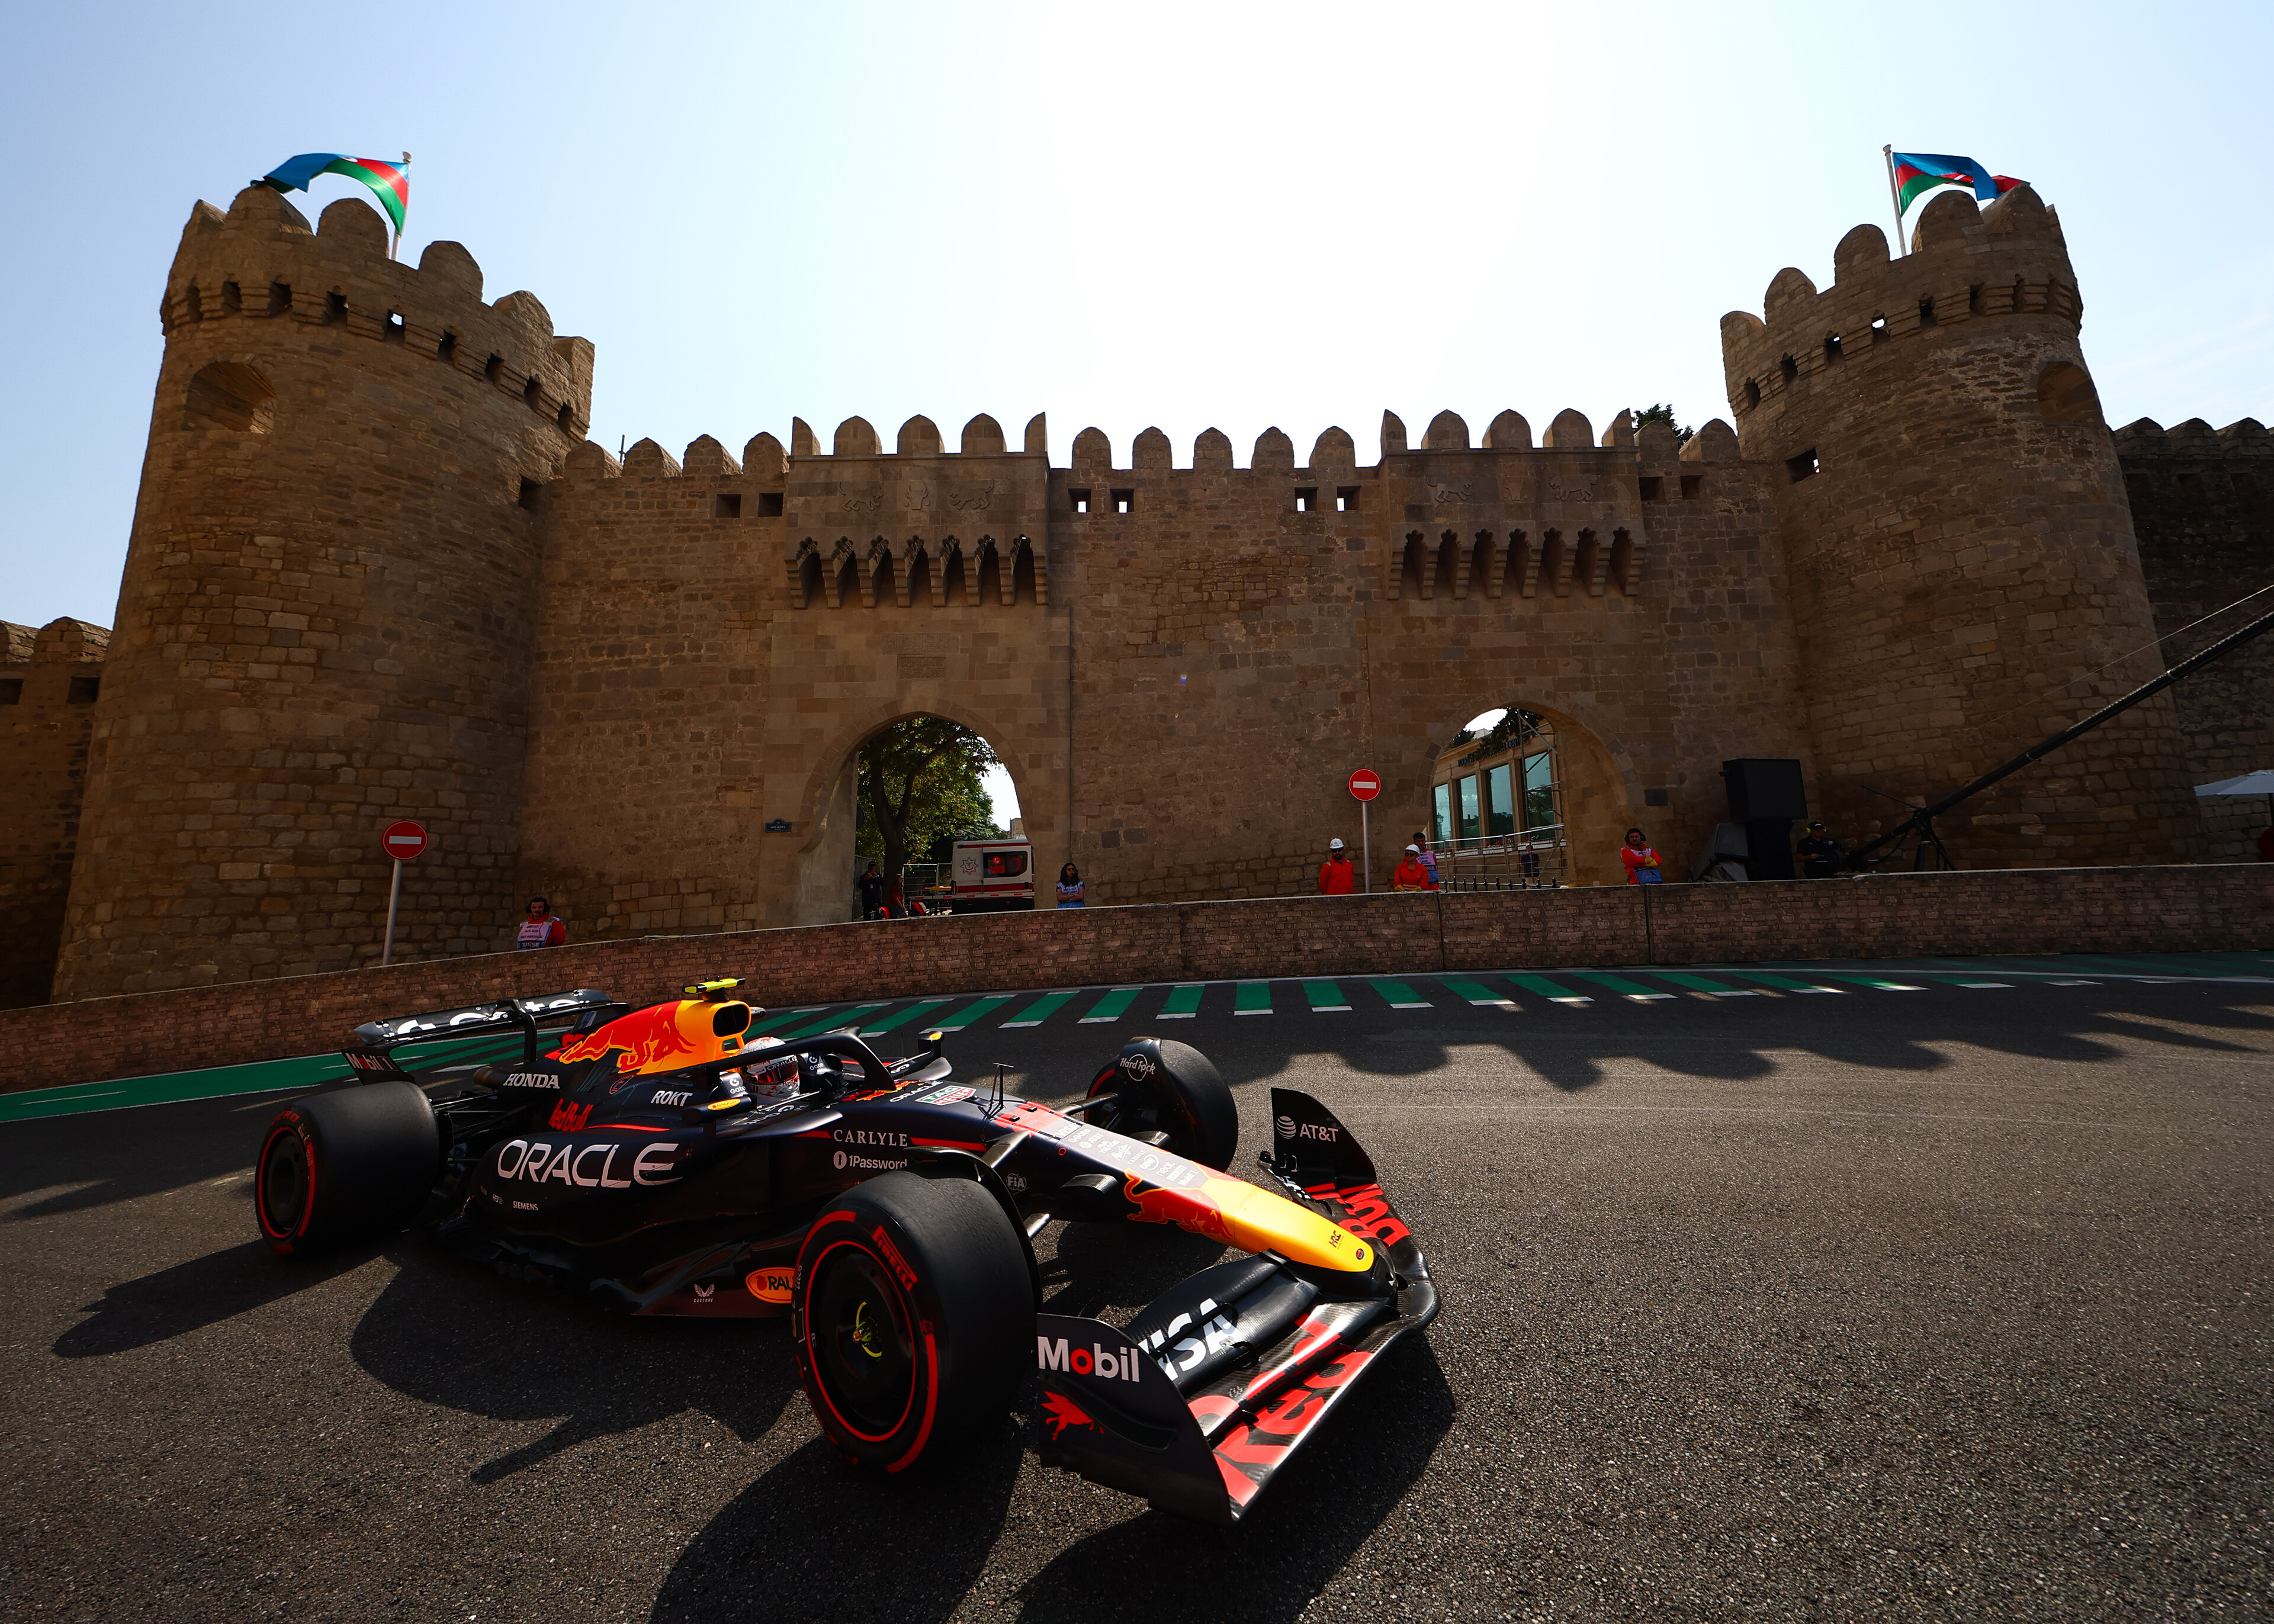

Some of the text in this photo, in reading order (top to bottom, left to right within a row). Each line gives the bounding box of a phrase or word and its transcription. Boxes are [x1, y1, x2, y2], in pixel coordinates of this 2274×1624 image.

[345, 1052, 384, 1071] Mobil
[767, 1055, 795, 1071] ORACLE
[810, 1062, 824, 1071] Gate
[1120, 1057, 1156, 1075] Hard Rock
[503, 1073, 560, 1089] HONDA
[730, 1085, 747, 1094] Gate
[889, 1080, 943, 1102] ORACLE
[921, 1086, 959, 1102] TAG
[933, 1088, 971, 1105] HEUER
[650, 1090, 693, 1106] ROKT
[716, 1099, 737, 1108] RAUCH
[834, 1129, 907, 1147] CARLYLE
[1072, 1128, 1091, 1140] Gate
[1299, 1123, 1338, 1142] AT&T
[1099, 1140, 1120, 1153] TRADE
[497, 1139, 683, 1188] ORACLE
[849, 1155, 907, 1170] 1Password
[1127, 1150, 1146, 1165] CARLYLE
[1139, 1157, 1155, 1170] CDW
[1156, 1162, 1175, 1177] neat
[1178, 1171, 1195, 1186] Mobil
[513, 1201, 539, 1211] SIEMENS
[768, 1276, 794, 1291] RAU
[1038, 1336, 1140, 1382] Mobil
